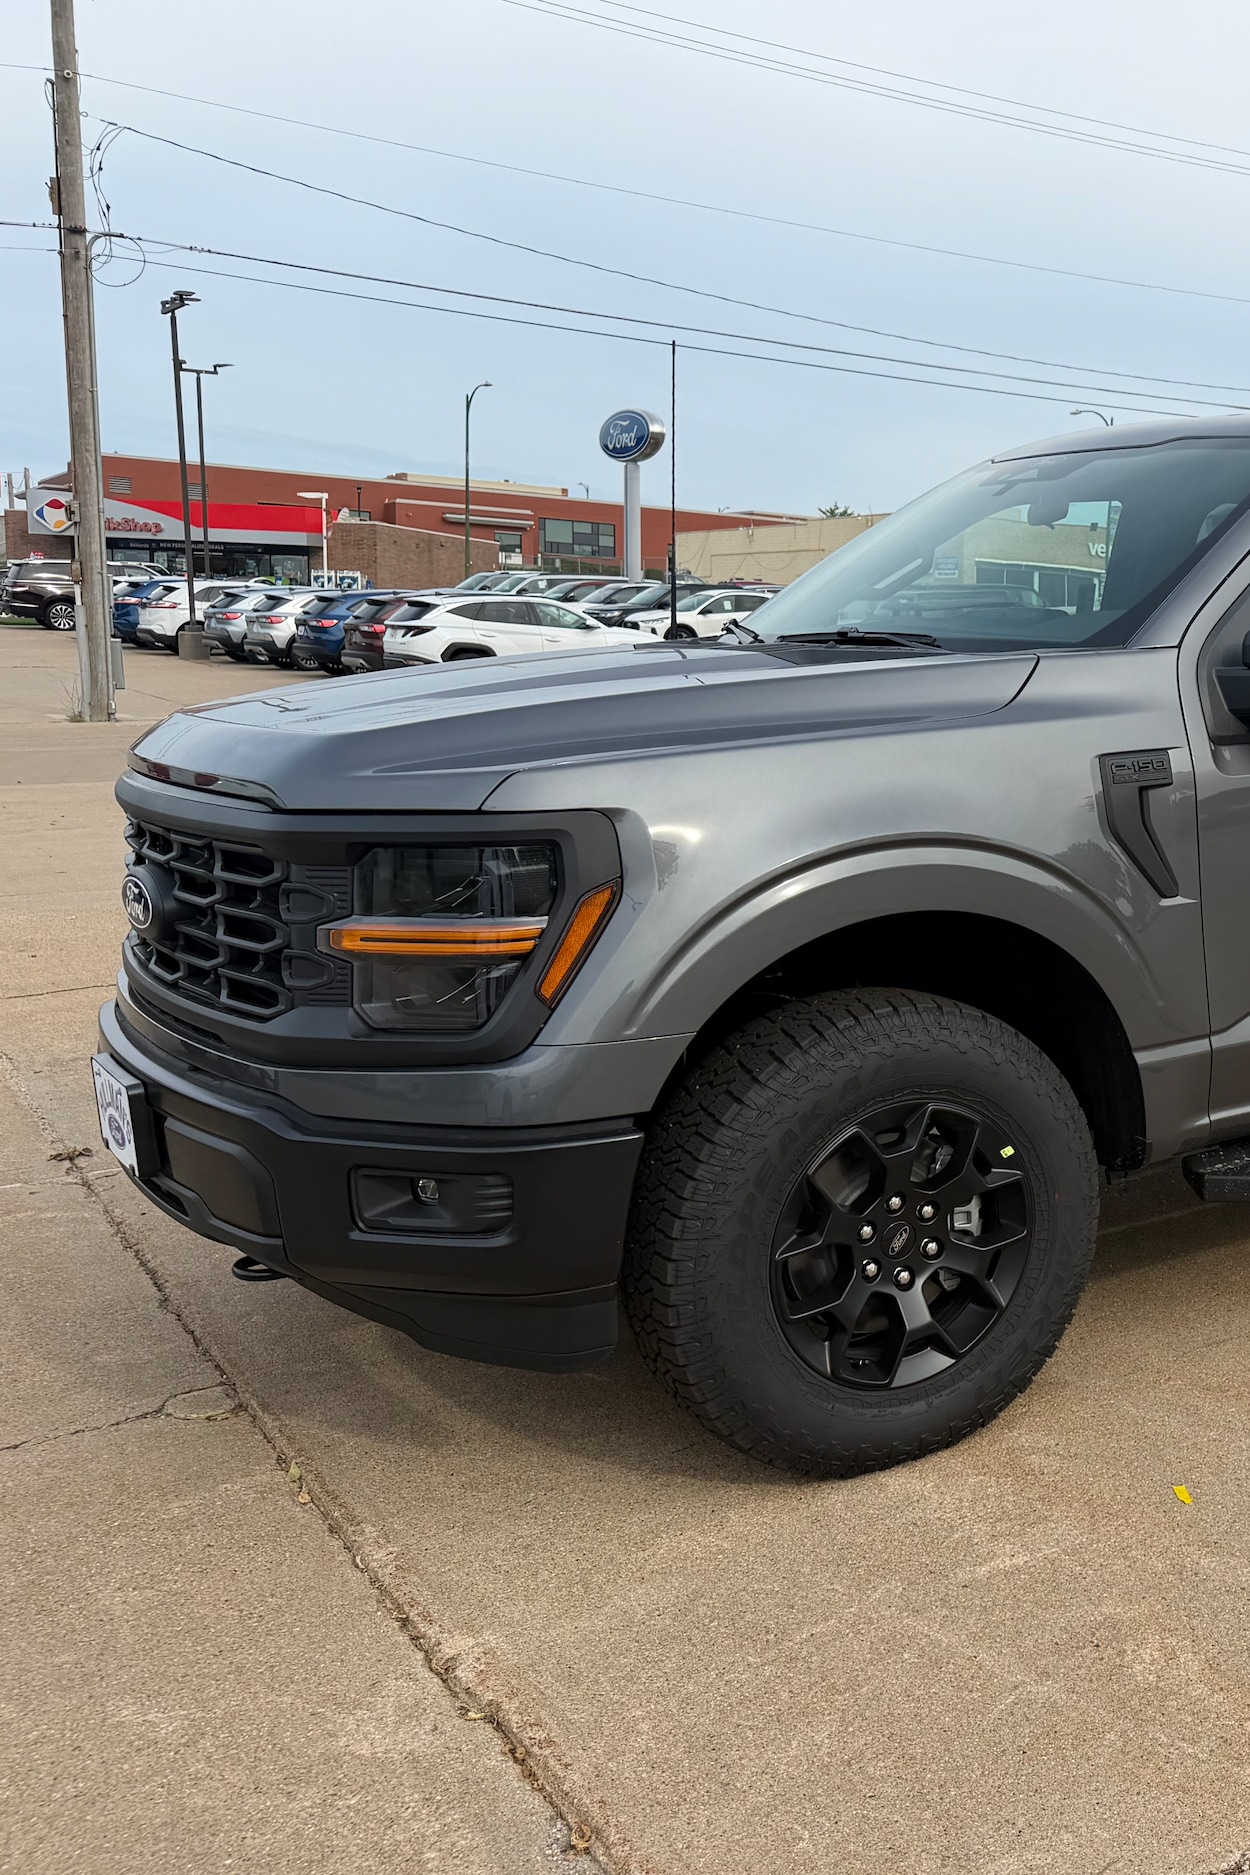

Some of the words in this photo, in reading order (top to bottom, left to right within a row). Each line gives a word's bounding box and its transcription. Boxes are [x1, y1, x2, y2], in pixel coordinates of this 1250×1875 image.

[607, 419, 638, 450] Ford
[1111, 758, 1167, 774] F-150
[125, 882, 145, 922] Ford
[892, 1230, 907, 1251] Ford
